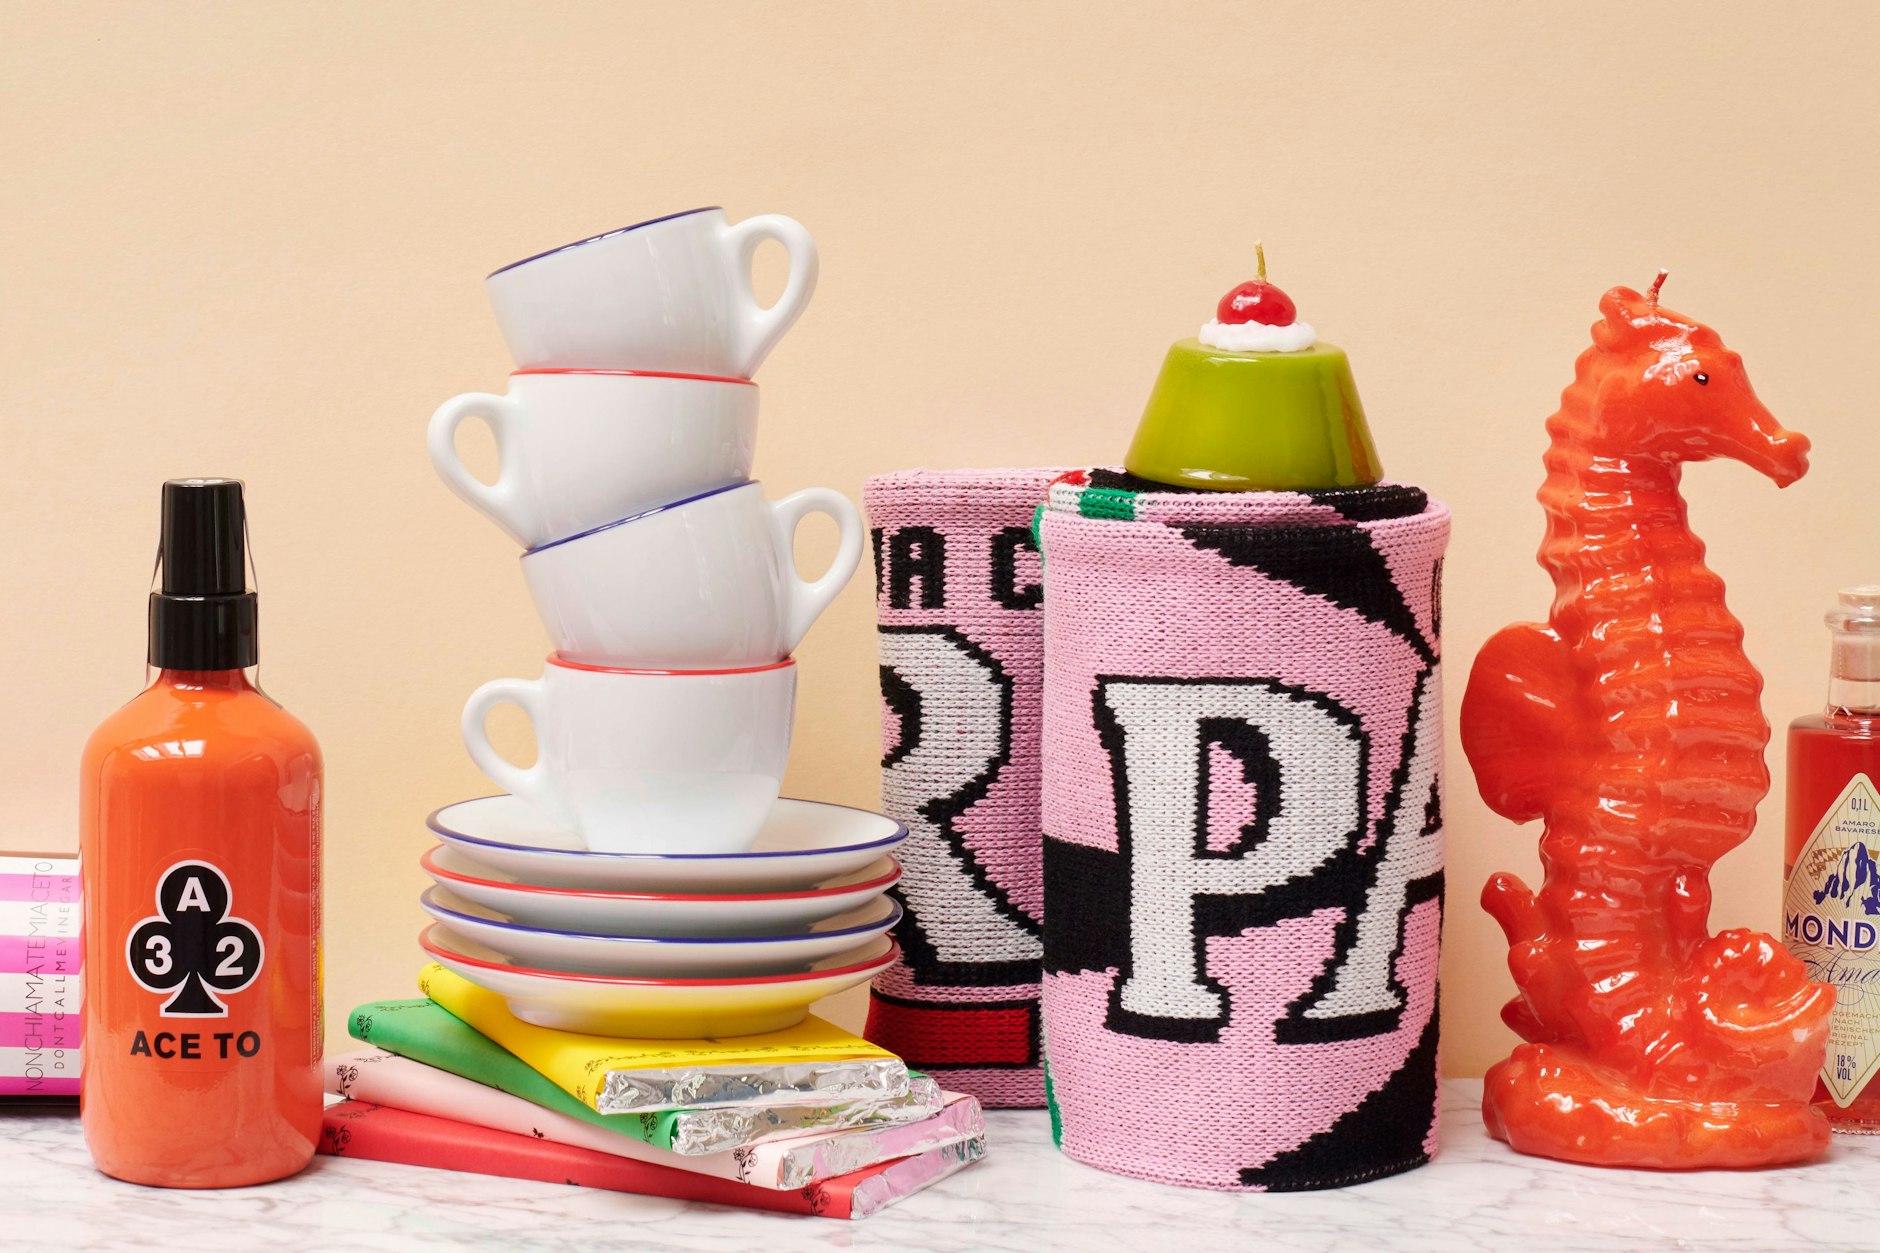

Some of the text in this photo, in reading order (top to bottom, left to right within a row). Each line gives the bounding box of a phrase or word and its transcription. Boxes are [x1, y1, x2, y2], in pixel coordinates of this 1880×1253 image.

[176, 877, 211, 912] A
[1785, 908, 1876, 949] MOND
[144, 934, 245, 977] 3 2
[25, 862, 53, 1091] NONCHIAMATEMIACETO
[1832, 1010, 1880, 1019] DGEMACH
[130, 1030, 261, 1059] ACE TO
[1831, 1032, 1868, 1040] RIGINAL
[1837, 1067, 1852, 1081] VOL
